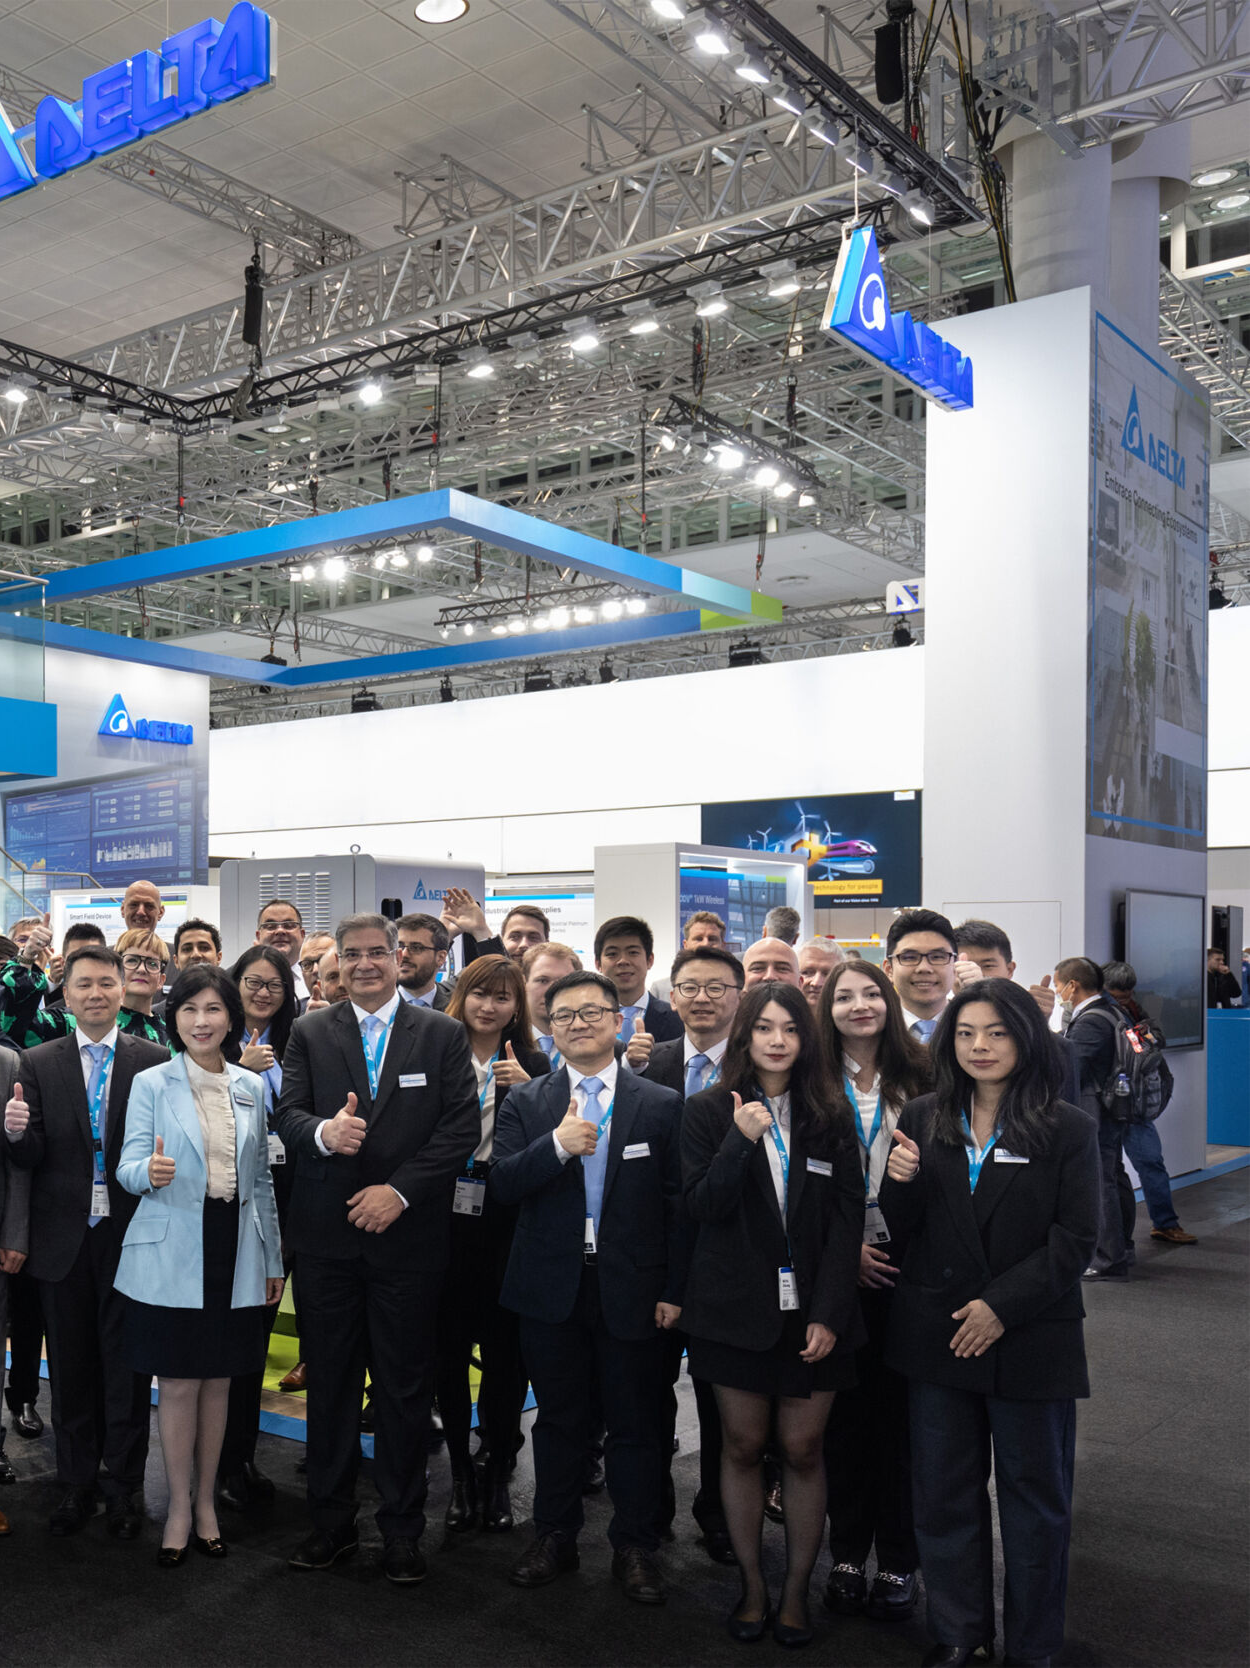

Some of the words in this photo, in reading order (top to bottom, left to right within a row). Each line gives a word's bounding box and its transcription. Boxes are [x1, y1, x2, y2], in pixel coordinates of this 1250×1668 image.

[35, 1, 272, 179] DELTA
[1148, 432, 1185, 490] DELTA
[1105, 471, 1132, 502] Embrace
[1133, 490, 1166, 528] Connecting
[1166, 511, 1198, 544] Ecosystems
[136, 718, 193, 745] DELTA
[429, 889, 448, 900] DELT
